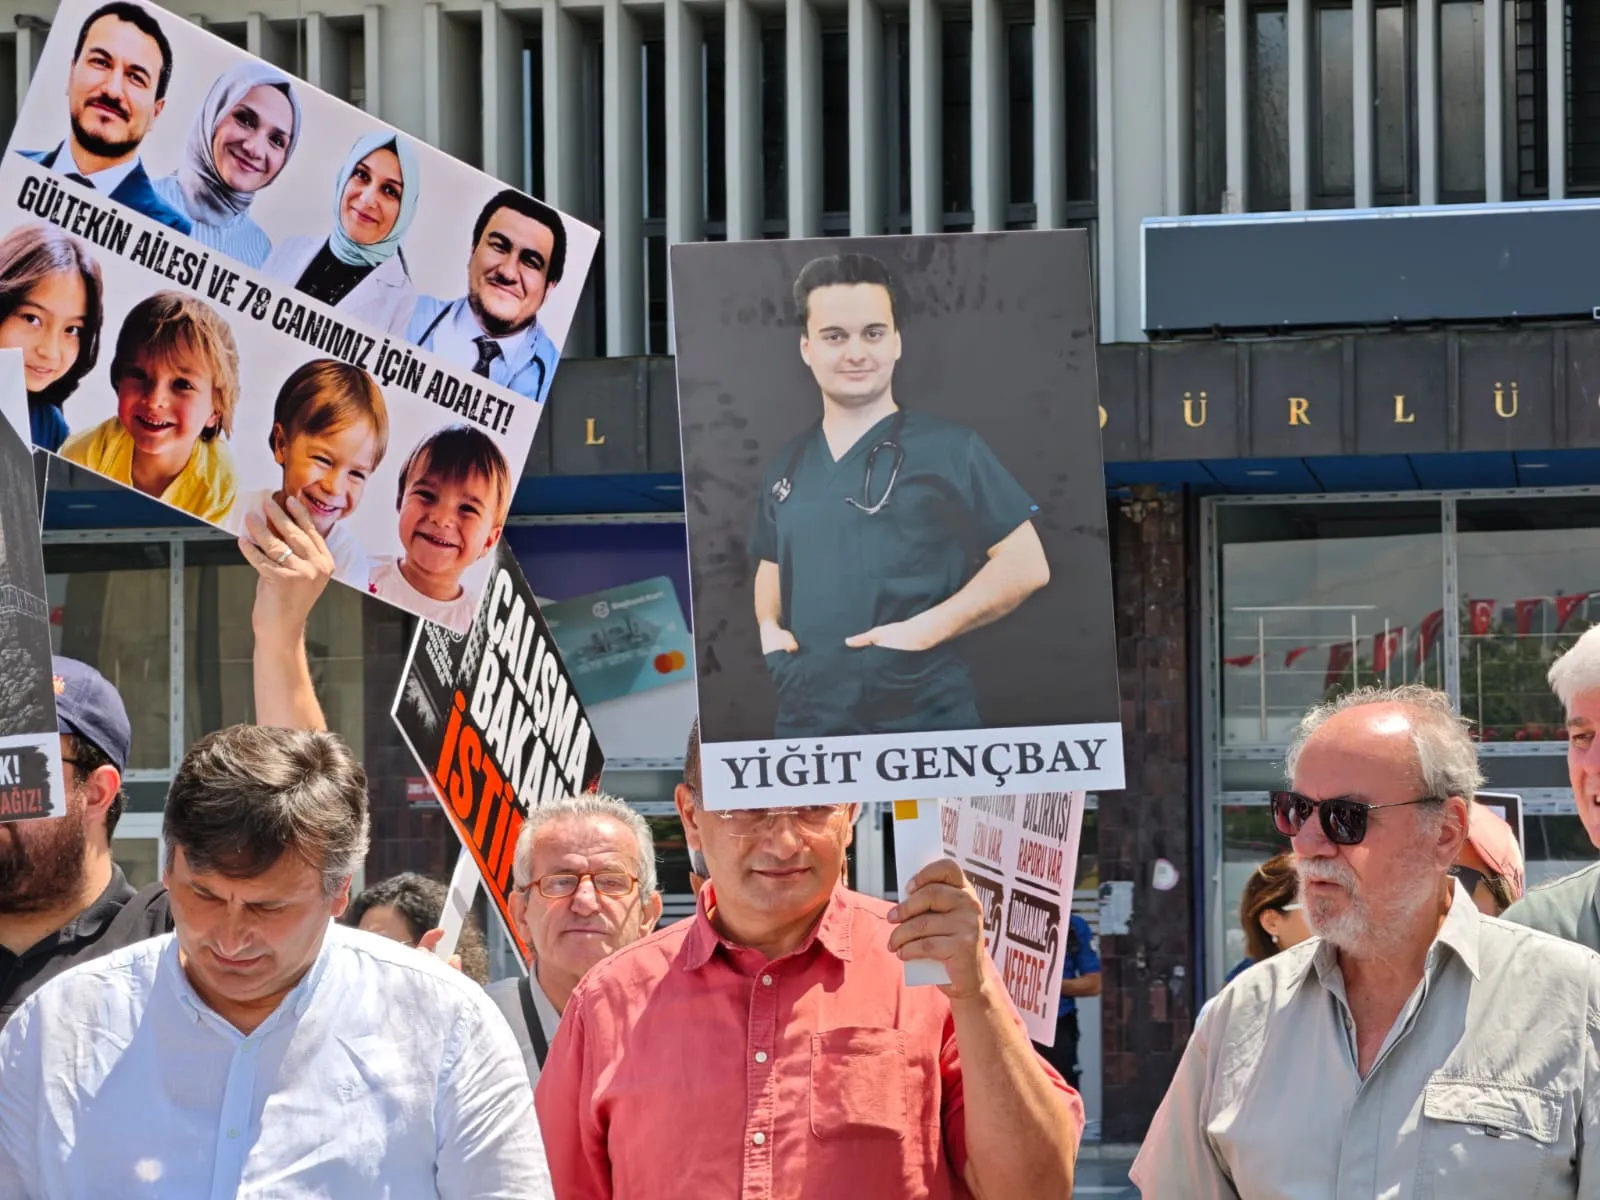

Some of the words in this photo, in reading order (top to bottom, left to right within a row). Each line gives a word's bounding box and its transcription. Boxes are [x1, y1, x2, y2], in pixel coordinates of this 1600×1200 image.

[17, 175, 132, 256] GÜLTEKİN
[132, 225, 210, 291] AİLESİ
[207, 263, 237, 305] VE
[237, 279, 272, 320] 78
[271, 300, 378, 373] CANIMIZ
[374, 337, 425, 395] İÇİN
[424, 371, 517, 435] ADALET!
[486, 569, 590, 797] ÇALIŞMA
[721, 742, 862, 790] YİĞİT
[875, 738, 1107, 788] GENÇBAY
